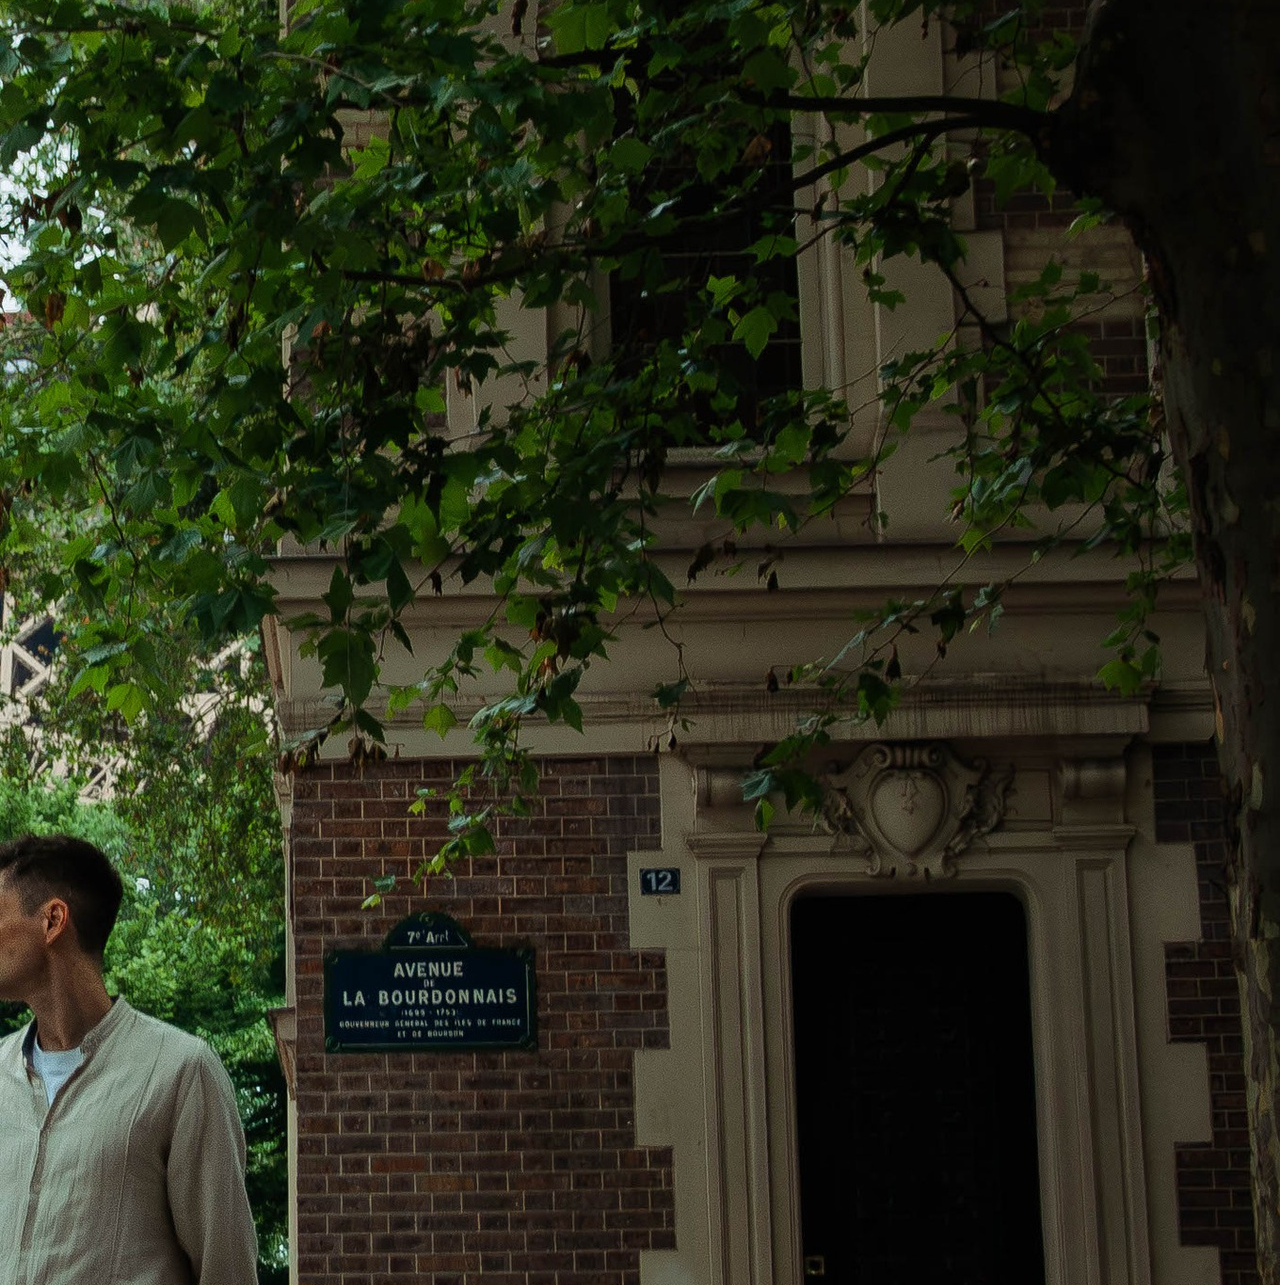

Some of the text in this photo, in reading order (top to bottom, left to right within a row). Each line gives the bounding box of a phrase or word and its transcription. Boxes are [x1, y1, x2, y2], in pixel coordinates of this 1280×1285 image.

[646, 871, 673, 891] 12
[393, 961, 464, 978] AVENUE
[343, 988, 518, 1007] LA BOURDONNAIS
